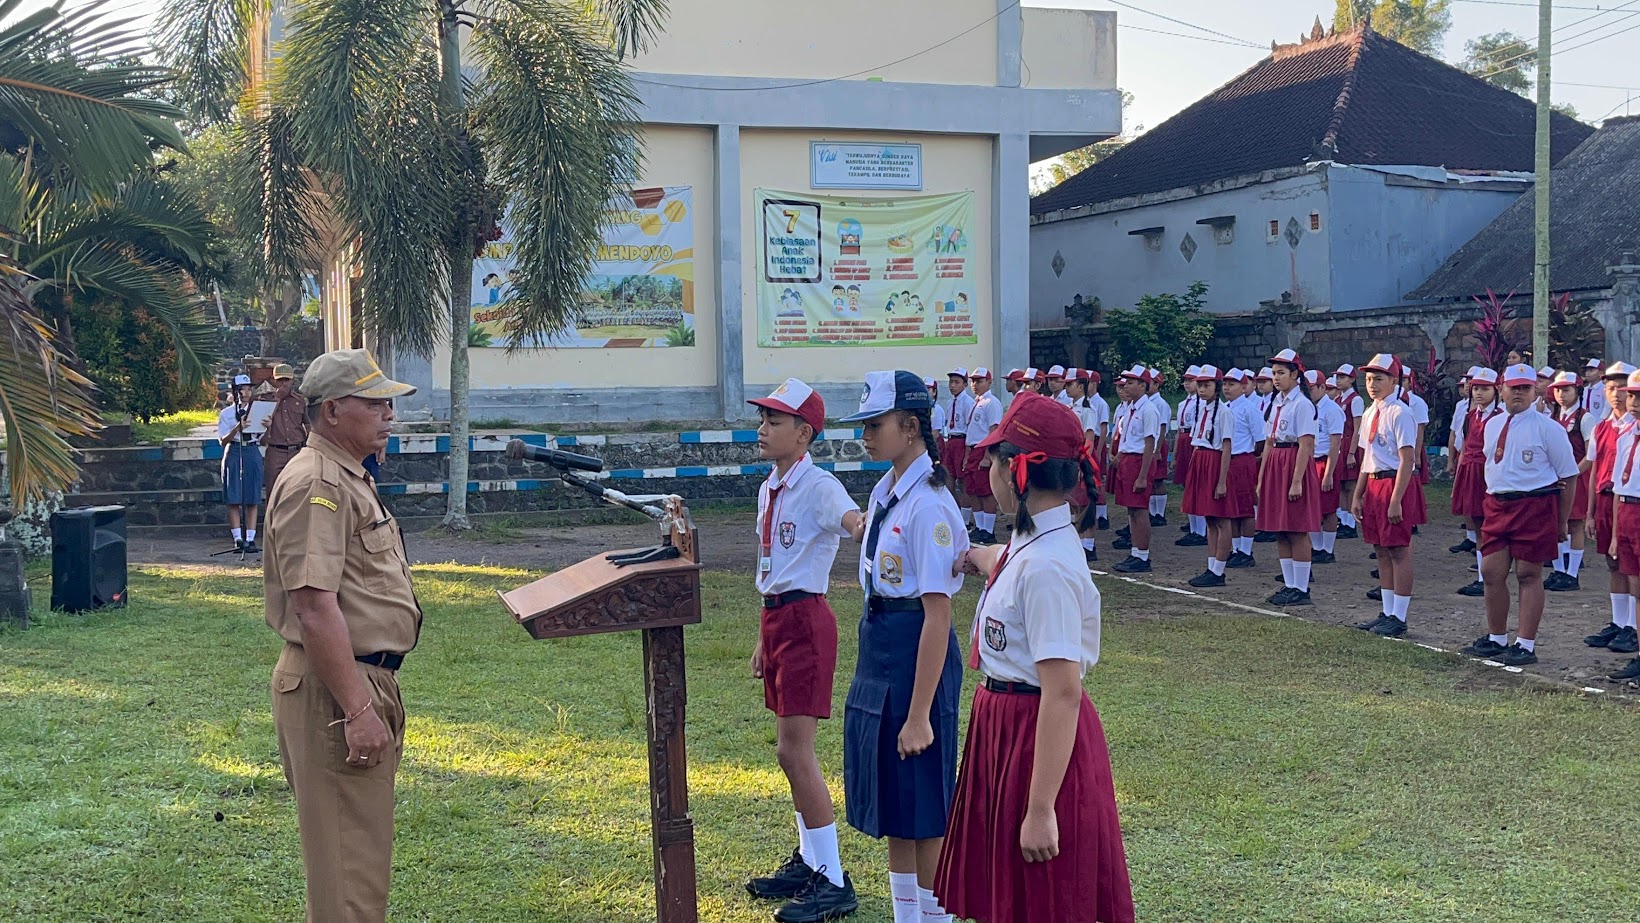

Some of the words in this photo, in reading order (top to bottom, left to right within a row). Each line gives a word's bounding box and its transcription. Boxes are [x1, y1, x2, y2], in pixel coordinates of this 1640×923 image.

[783, 209, 800, 234] 7
[769, 236, 816, 246] Kebiasaan
[596, 244, 673, 261] MENDOYO
[781, 246, 805, 255] Anak
[771, 255, 815, 265] Indonesia
[780, 265, 807, 274] Hebat
